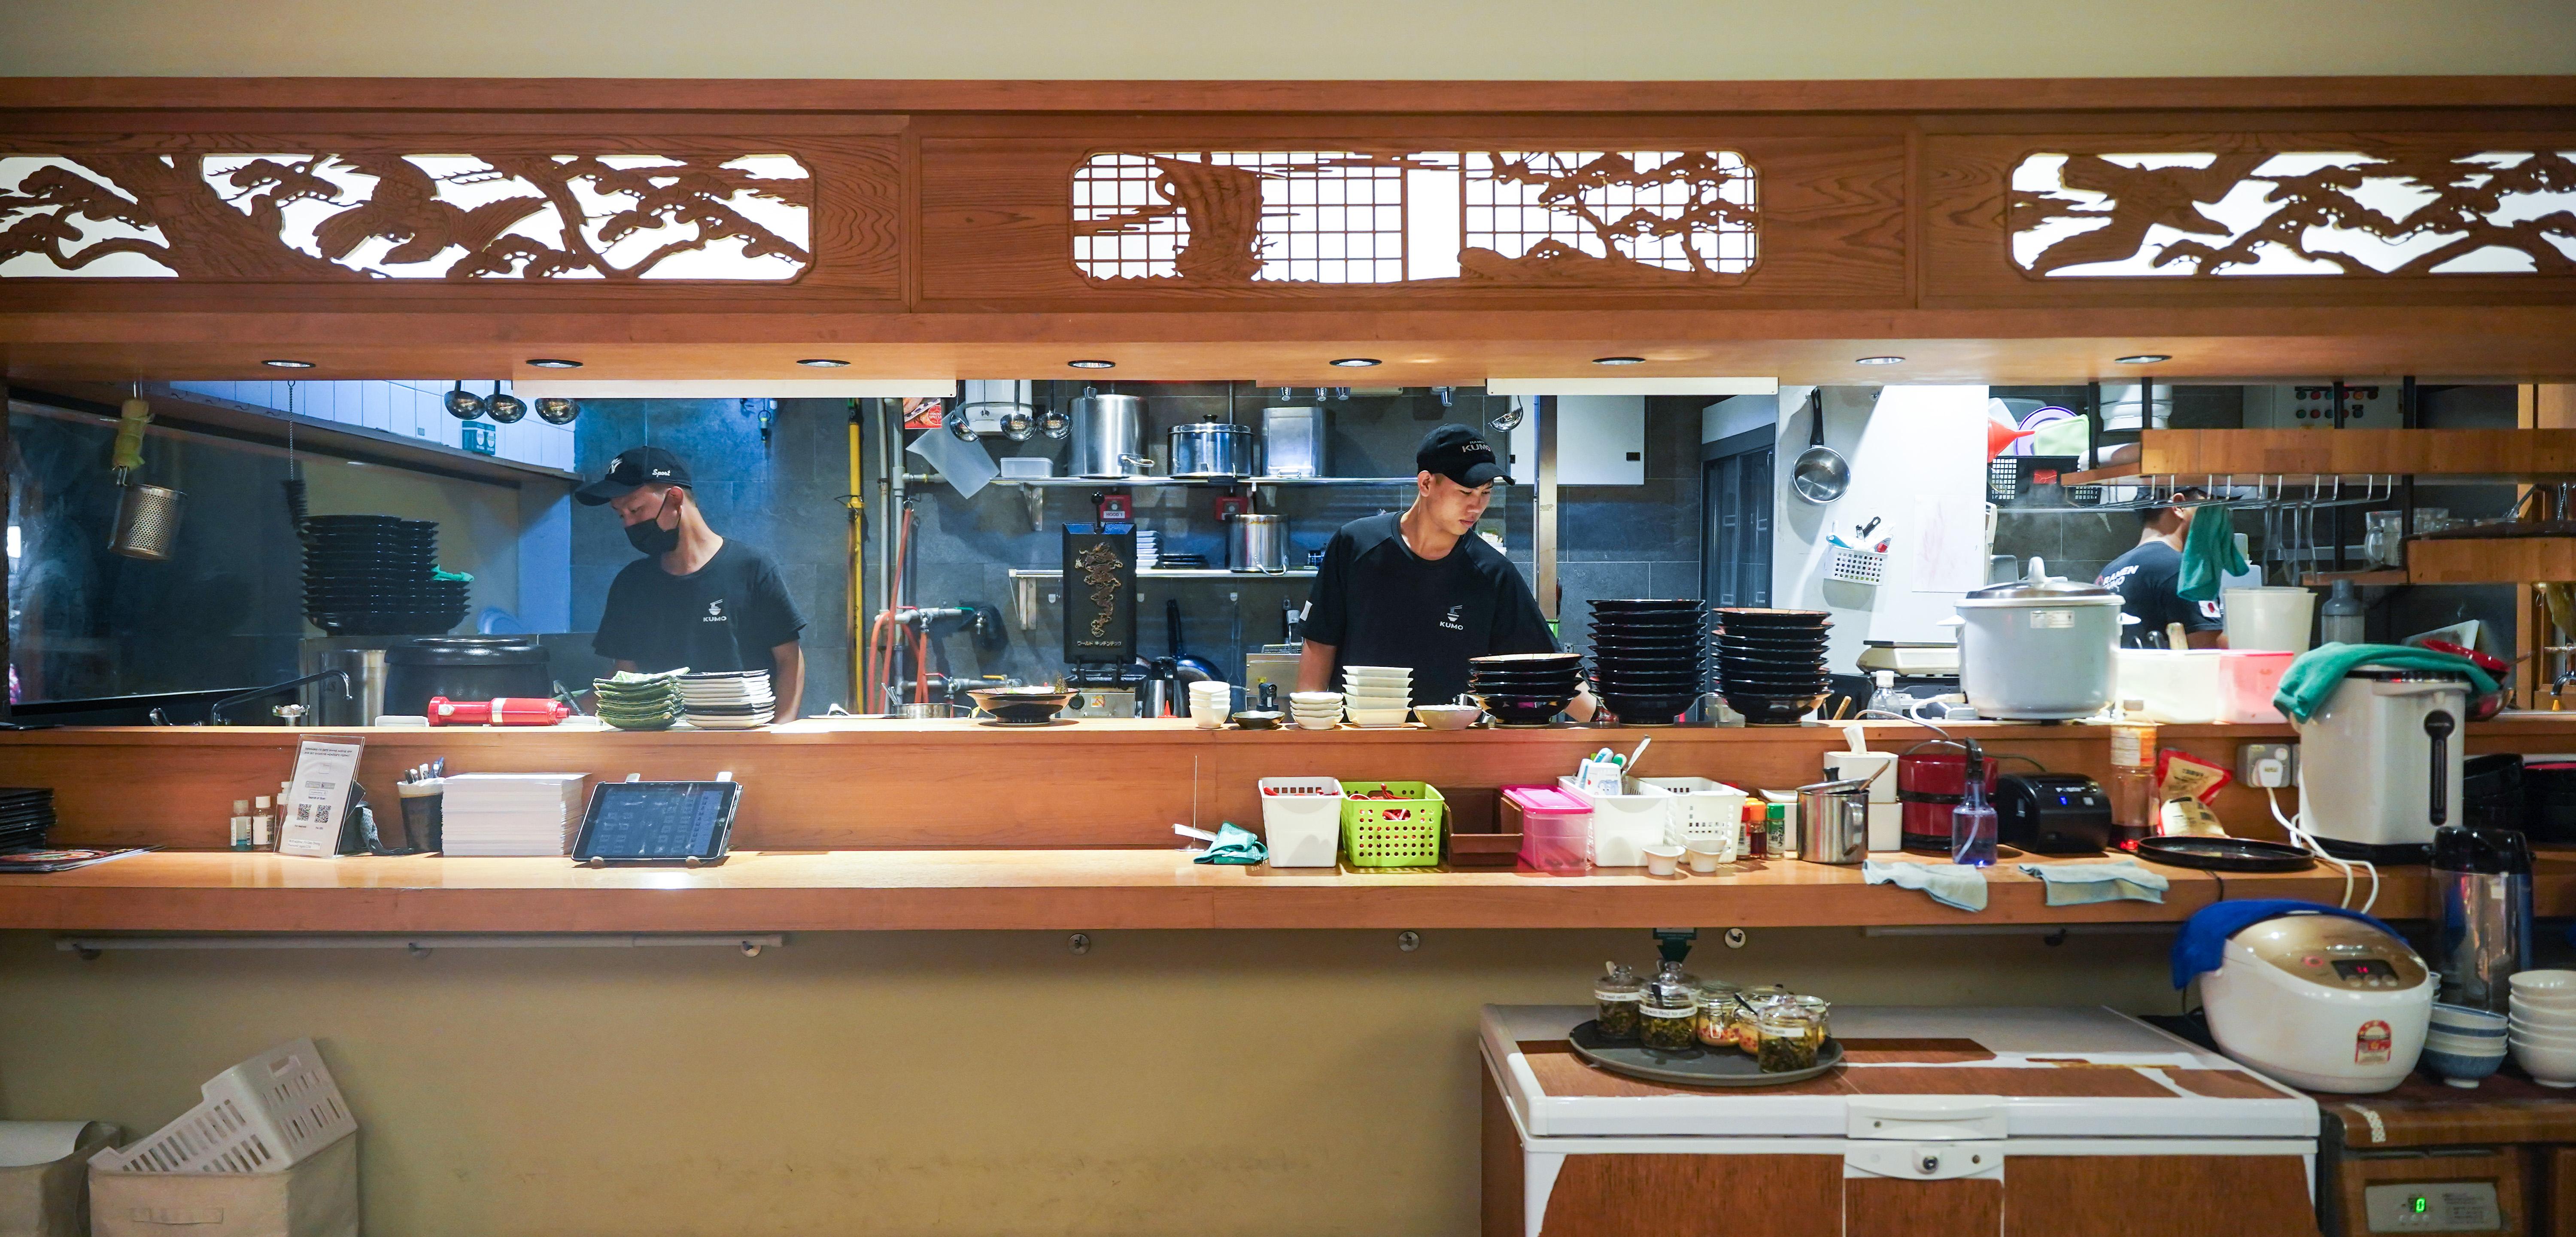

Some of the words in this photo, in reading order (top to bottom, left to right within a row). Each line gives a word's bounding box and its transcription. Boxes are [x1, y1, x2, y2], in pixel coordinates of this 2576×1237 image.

[652, 468, 671, 477] Sport
[2103, 565, 2139, 586] RAMEN
[1440, 621, 1464, 630] KUMO
